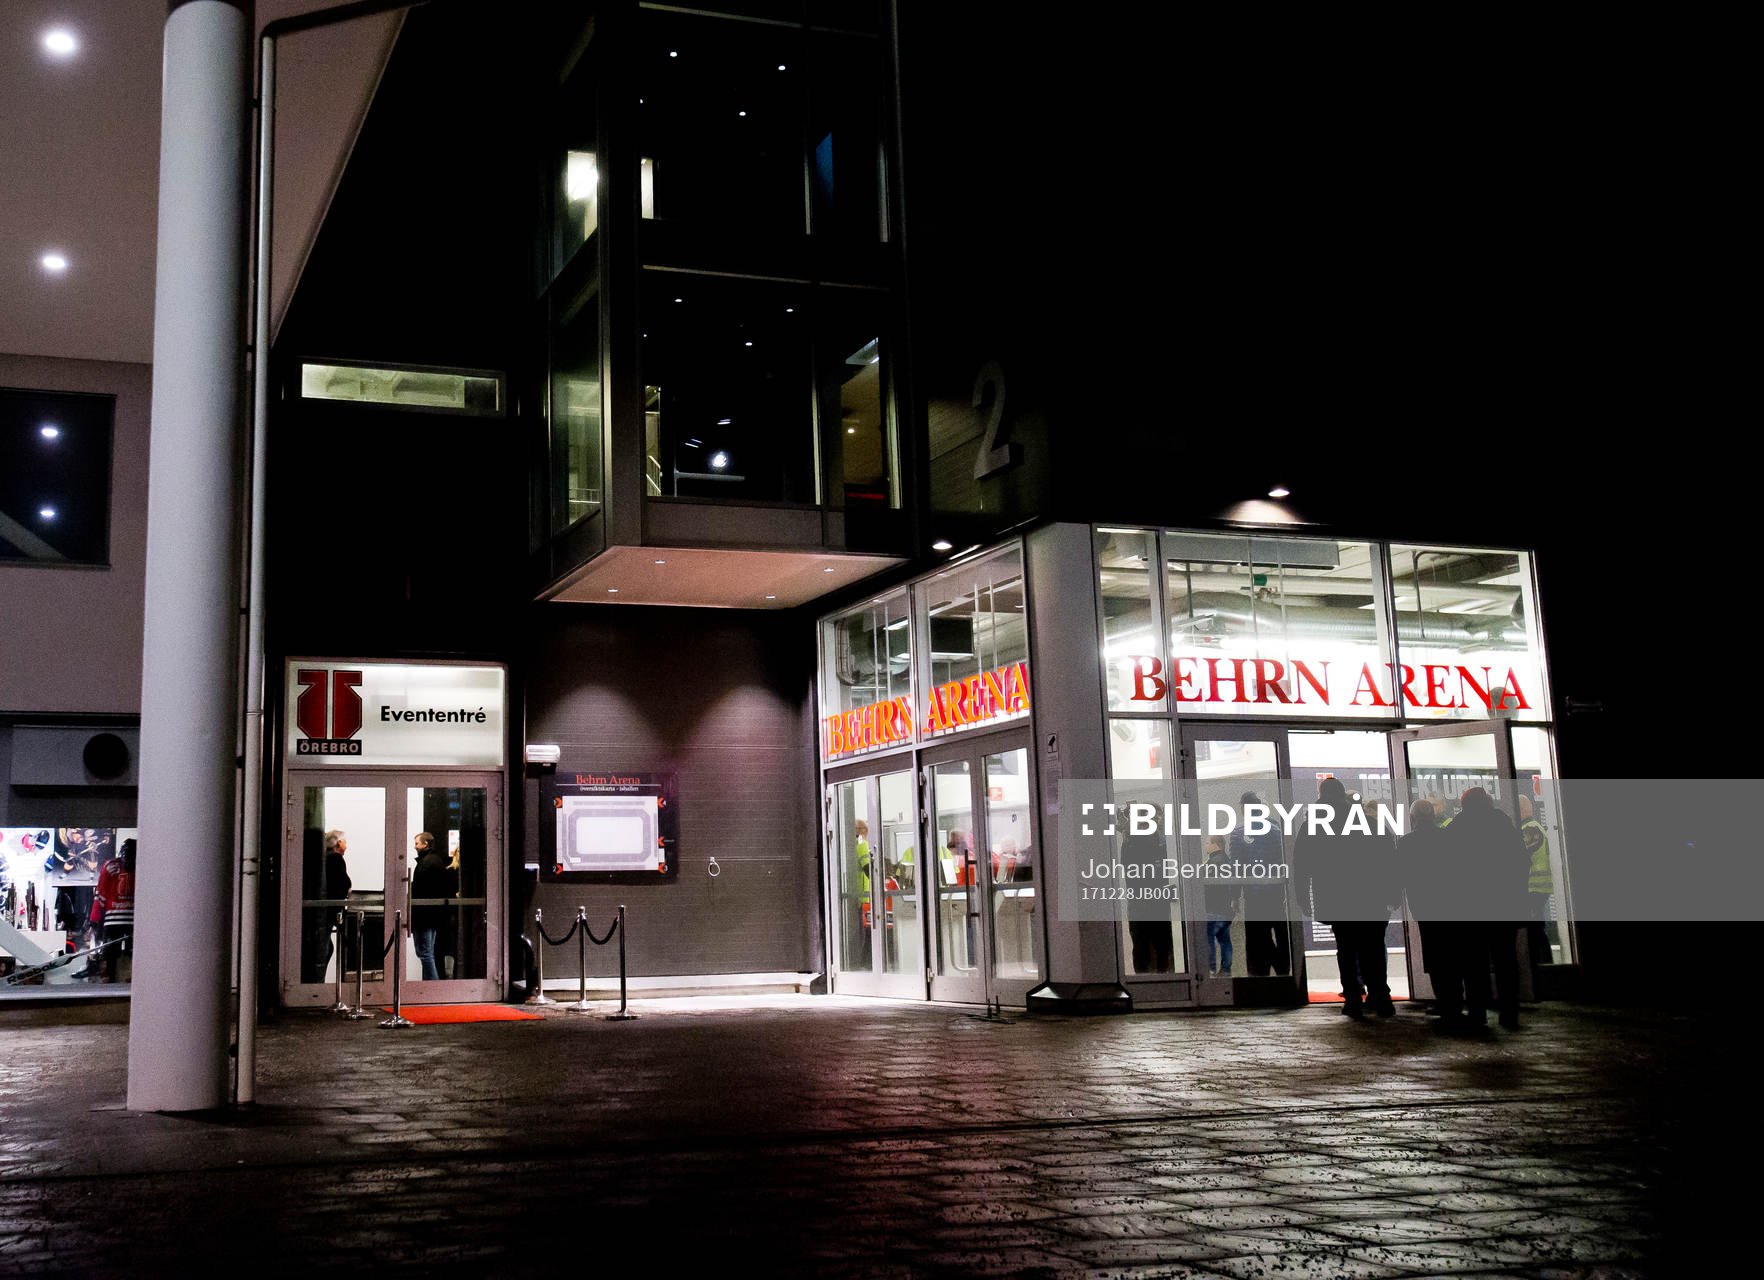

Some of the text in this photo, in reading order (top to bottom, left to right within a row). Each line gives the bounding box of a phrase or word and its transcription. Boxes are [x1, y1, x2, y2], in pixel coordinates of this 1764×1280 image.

[972, 360, 1011, 480] 2
[1130, 656, 1533, 711] BEHRN ARENA
[380, 705, 487, 723] Evententré
[827, 661, 1031, 756] BEHRN ARENA
[299, 741, 359, 753] ÖREBRO
[576, 774, 641, 785] Behrn Arena
